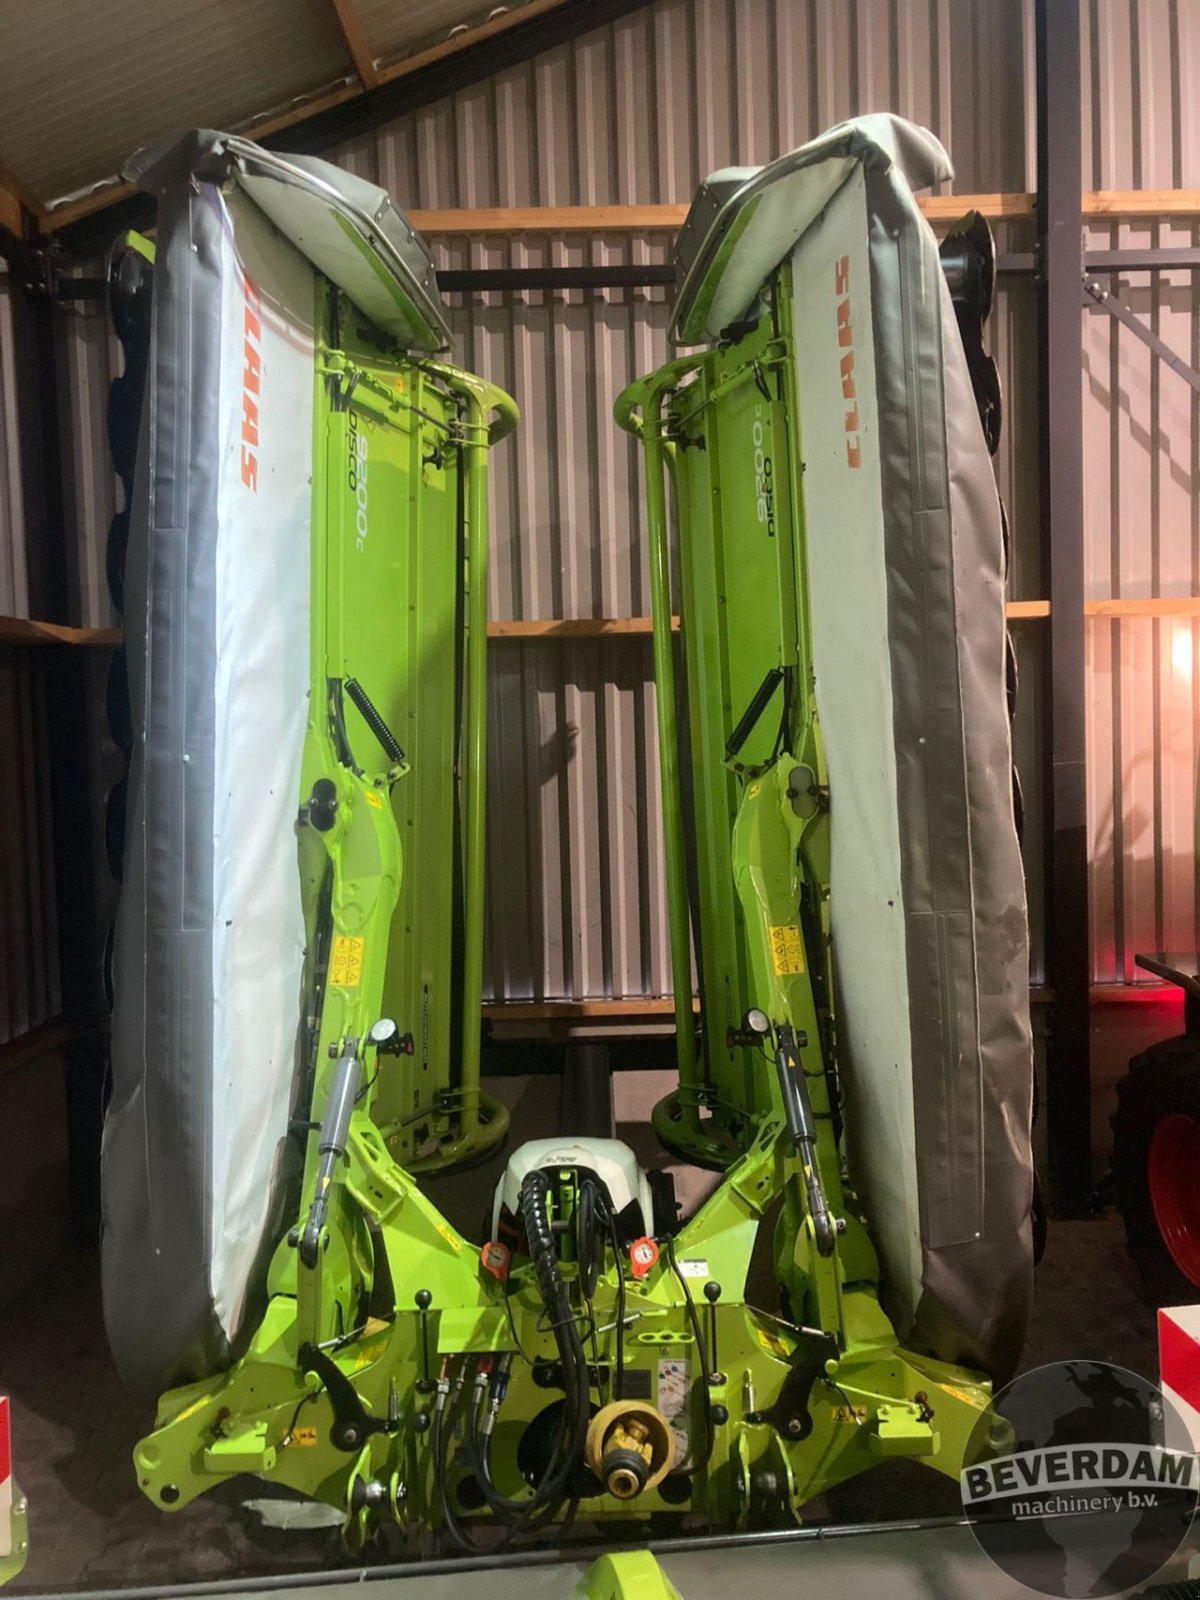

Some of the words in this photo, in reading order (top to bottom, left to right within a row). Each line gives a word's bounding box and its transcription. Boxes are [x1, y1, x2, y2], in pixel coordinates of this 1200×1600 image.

[835, 255, 861, 468] CLAAS
[349, 411, 358, 492] DISCO
[763, 456, 775, 537] DISCO
